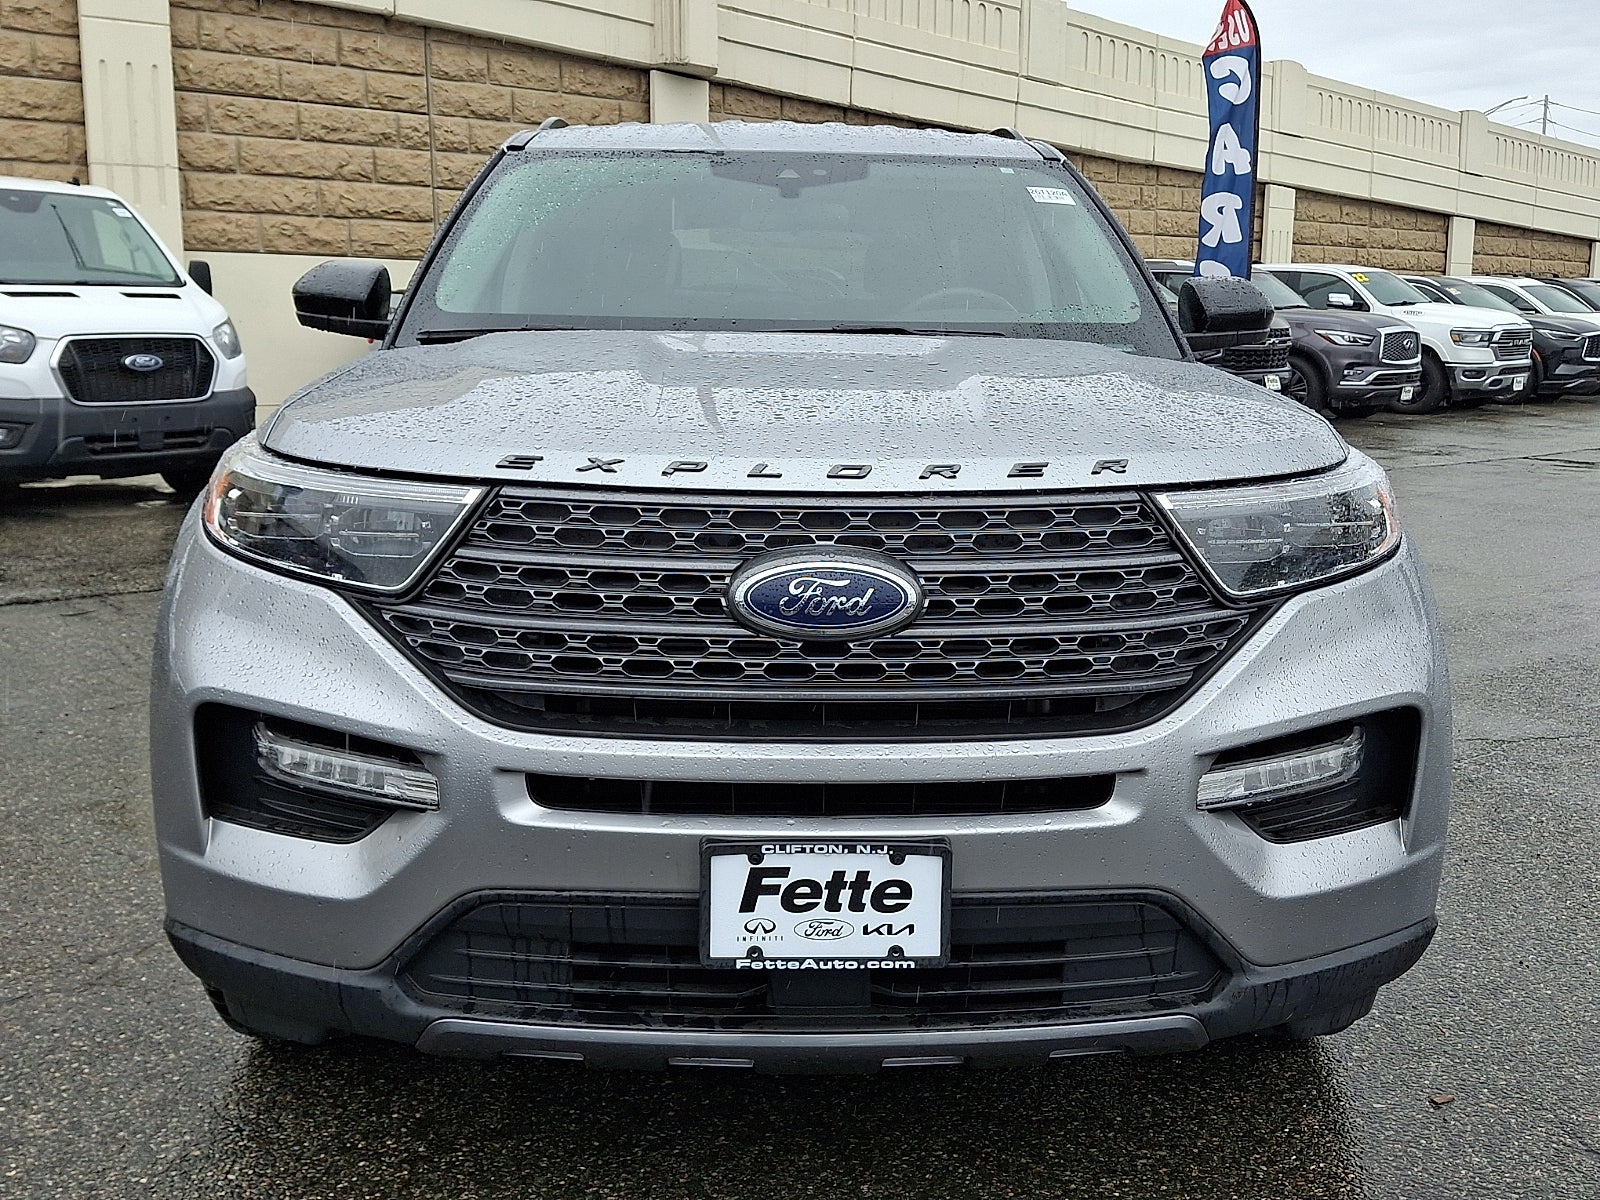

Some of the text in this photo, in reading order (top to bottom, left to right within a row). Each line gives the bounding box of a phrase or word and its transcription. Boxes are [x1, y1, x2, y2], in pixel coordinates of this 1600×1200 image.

[495, 455, 1129, 480] EXPLORER
[778, 576, 876, 616] Ford
[761, 844, 894, 855] CLIFTON, N.J.
[738, 866, 914, 914] Fette
[804, 920, 843, 938] Ford
[736, 958, 916, 969] FetteAuto.com
